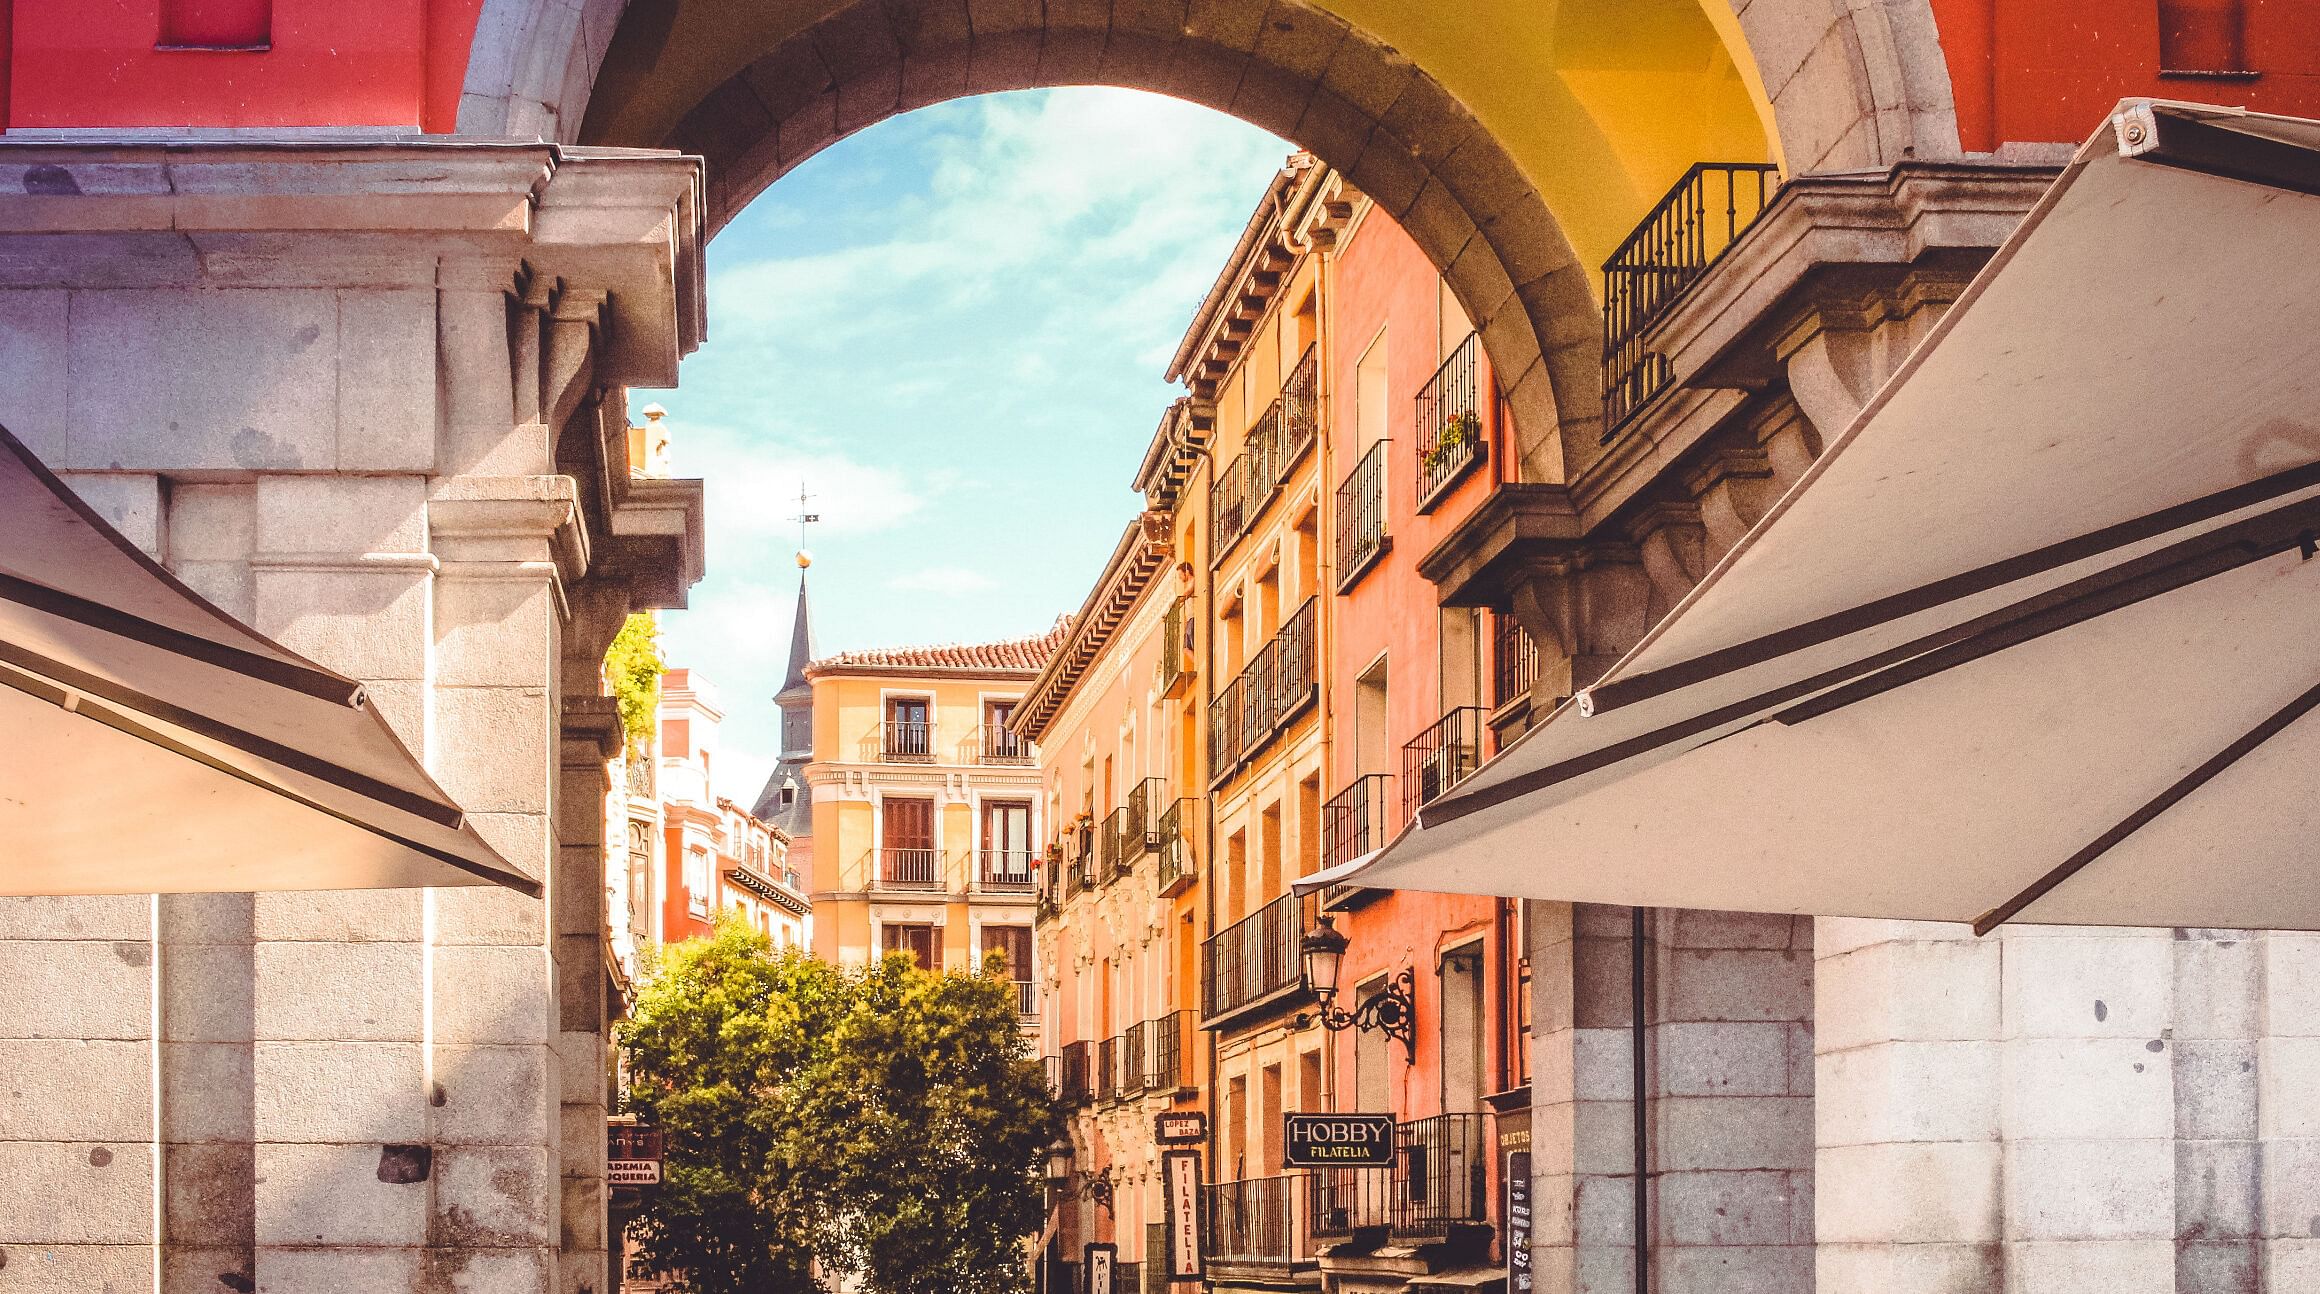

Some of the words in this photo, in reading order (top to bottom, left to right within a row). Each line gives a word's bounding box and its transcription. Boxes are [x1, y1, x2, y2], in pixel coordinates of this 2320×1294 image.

[1165, 1120, 1189, 1128] LOPEZ
[1292, 1122, 1388, 1143] HOBBY
[1310, 1146, 1370, 1158] FILATELIA
[1181, 1160, 1194, 1273] FILATELIA
